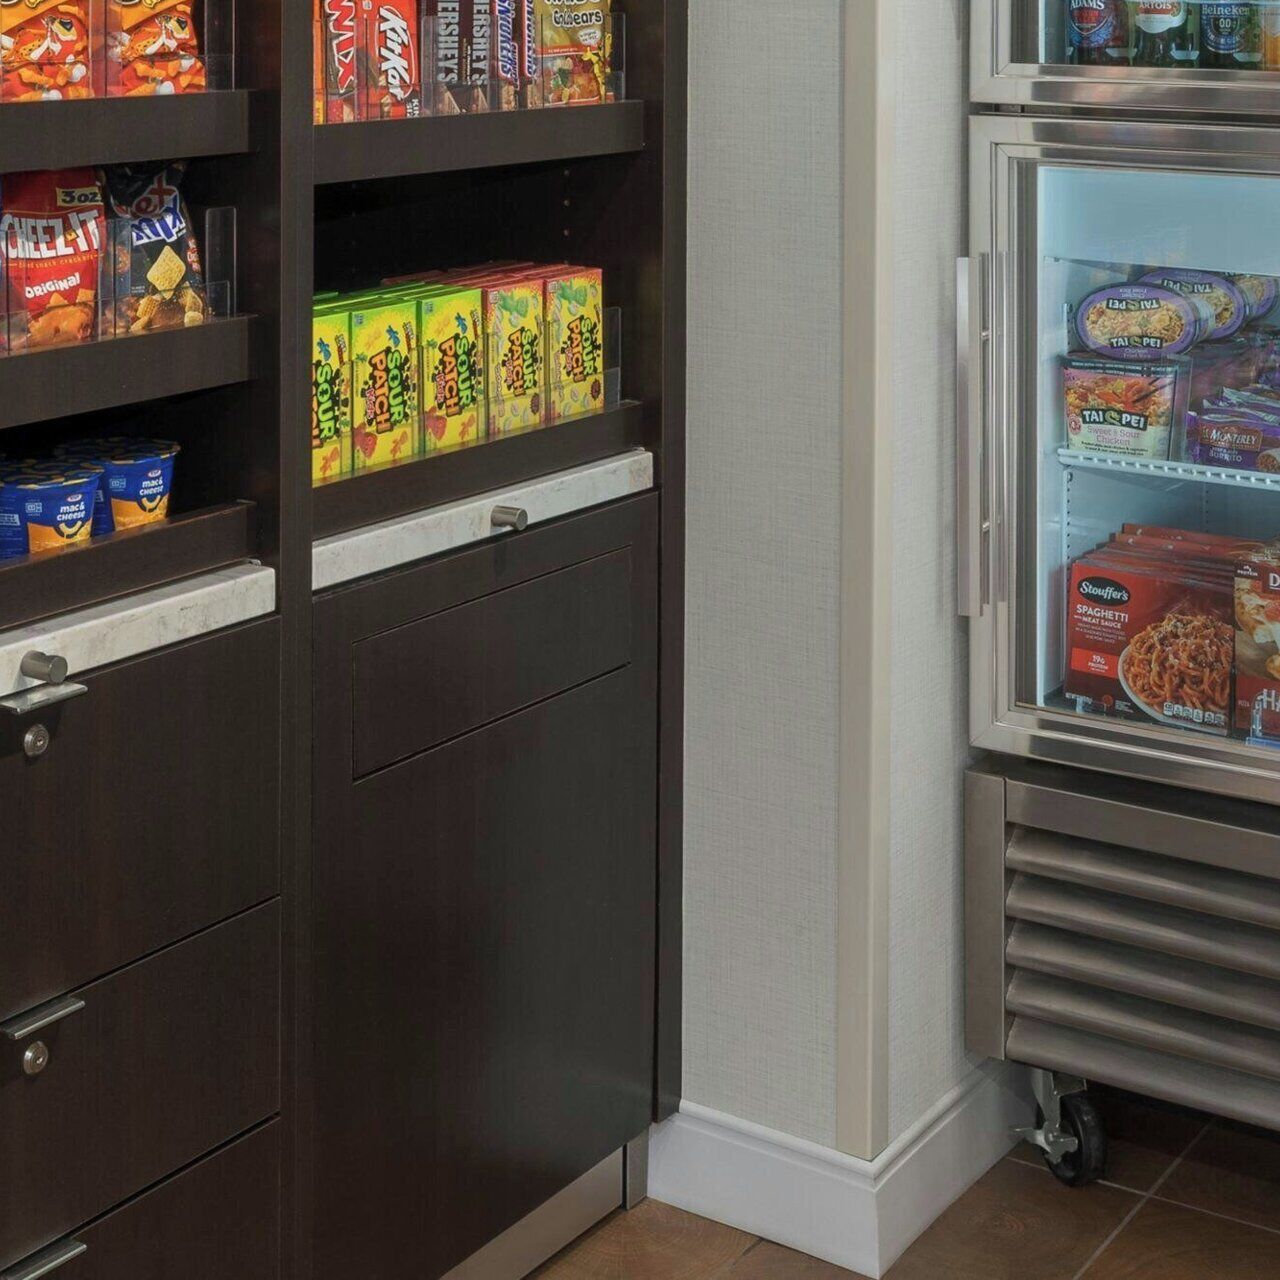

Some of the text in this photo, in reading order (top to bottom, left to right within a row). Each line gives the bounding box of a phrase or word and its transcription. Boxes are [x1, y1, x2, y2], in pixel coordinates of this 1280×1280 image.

[1201, 4, 1250, 16] Heineken
[0, 209, 100, 259] CHEEZ-IT
[456, 336, 474, 408] SOUR
[510, 329, 525, 396] PATCH
[521, 329, 536, 390] SOUR
[568, 318, 587, 383] PATCH
[581, 317, 595, 376] SOUR
[1110, 337, 1162, 349] TAI PEI
[317, 364, 336, 441] SOUR
[371, 349, 393, 433] PATCH
[387, 350, 406, 424] SOUR
[440, 337, 462, 418] PATCH
[1082, 410, 1146, 429] TAI PEI
[1076, 603, 1129, 623] SPAGHETTI
[1079, 581, 1129, 602] Stouffer's
[1082, 615, 1122, 629] MEAT SAUCE
